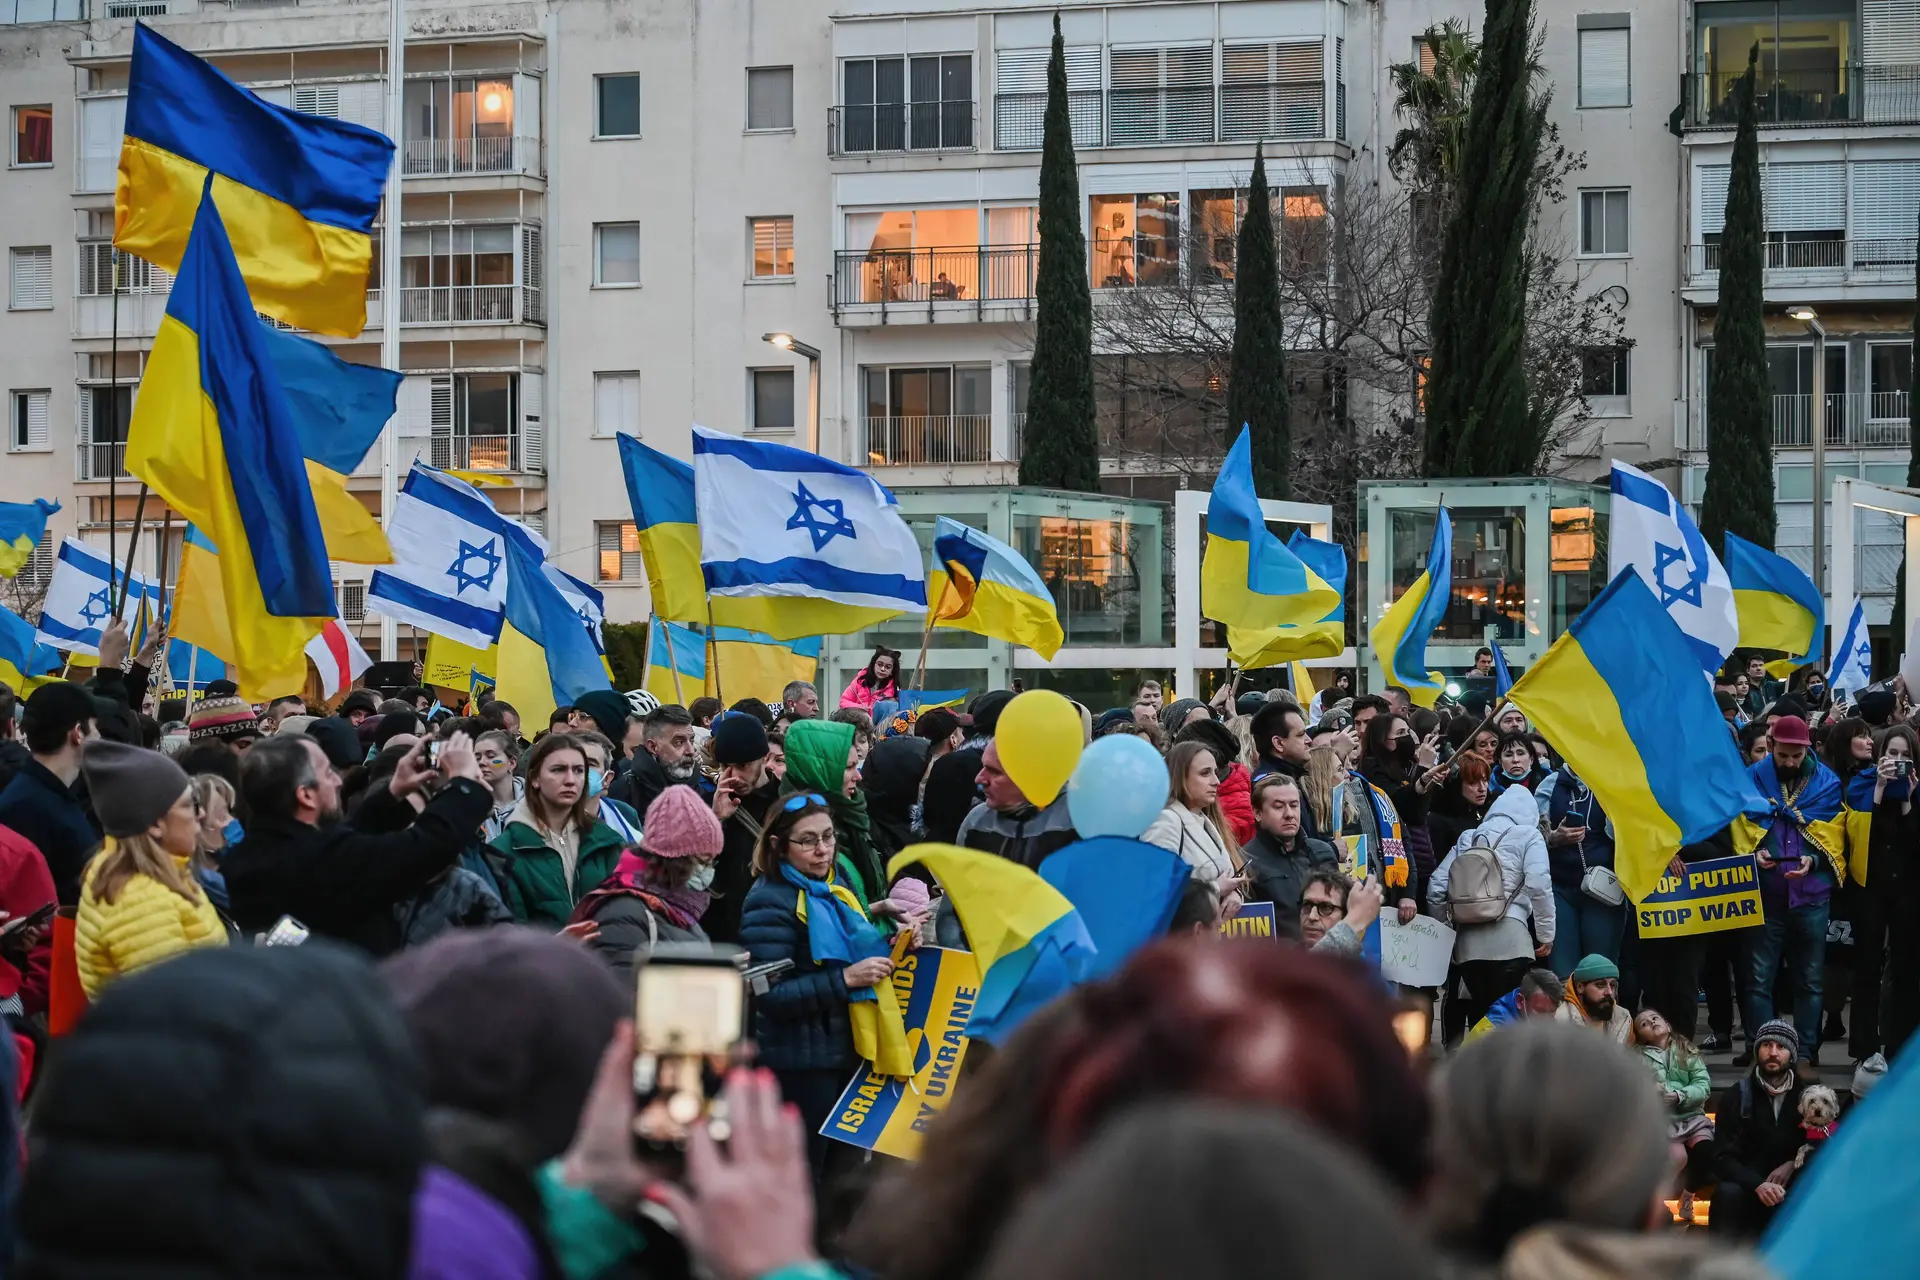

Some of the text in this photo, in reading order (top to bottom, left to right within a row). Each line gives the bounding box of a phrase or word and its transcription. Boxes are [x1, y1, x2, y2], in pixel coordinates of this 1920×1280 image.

[1656, 865, 1753, 894] OP PUTIN
[1219, 915, 1271, 939] PUTIN
[1640, 898, 1758, 928] STOP WAR
[836, 954, 918, 1134] ISRAE NDS
[925, 985, 977, 1097] UKRAINE
